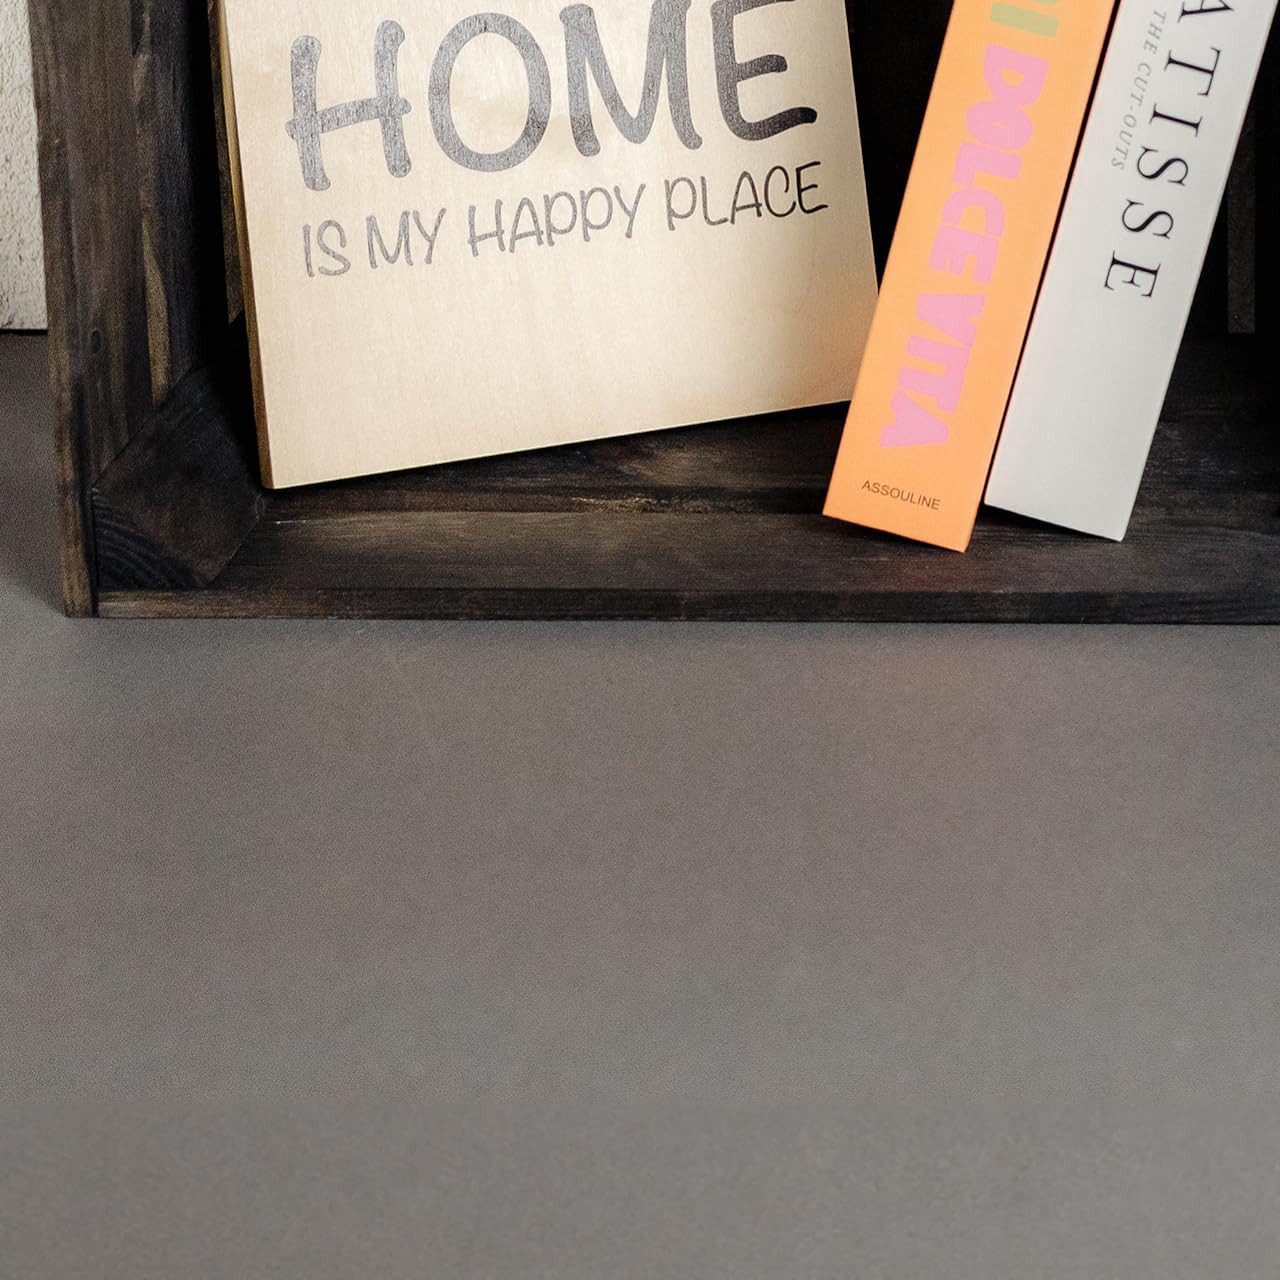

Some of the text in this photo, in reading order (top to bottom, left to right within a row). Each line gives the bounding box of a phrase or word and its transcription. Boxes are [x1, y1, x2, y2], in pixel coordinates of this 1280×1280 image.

[928, 42, 1050, 285] DOLCE
[1110, 7, 1168, 173] THE CUT-OUTS
[302, 160, 829, 278] IS MY HAPPY PLACE
[879, 291, 987, 449] VITA
[860, 479, 943, 511] ASSOULINE
